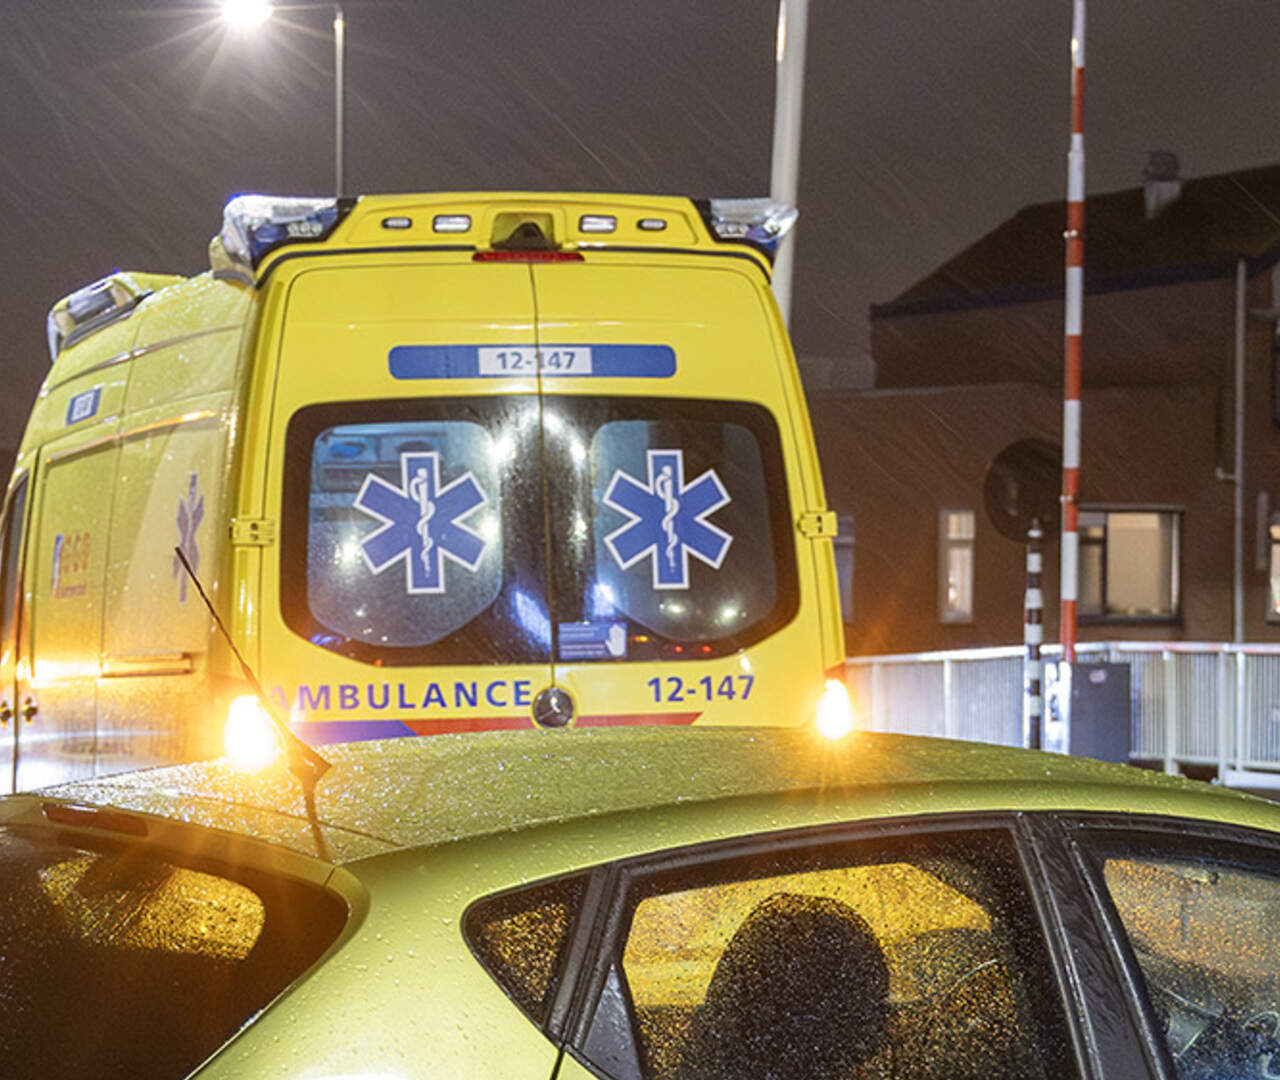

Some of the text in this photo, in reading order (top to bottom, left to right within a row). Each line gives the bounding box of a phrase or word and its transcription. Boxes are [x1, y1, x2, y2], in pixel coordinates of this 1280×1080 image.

[496, 351, 576, 370] 12-147
[269, 680, 532, 711] AMBULANCE
[648, 675, 755, 703] 12-147
